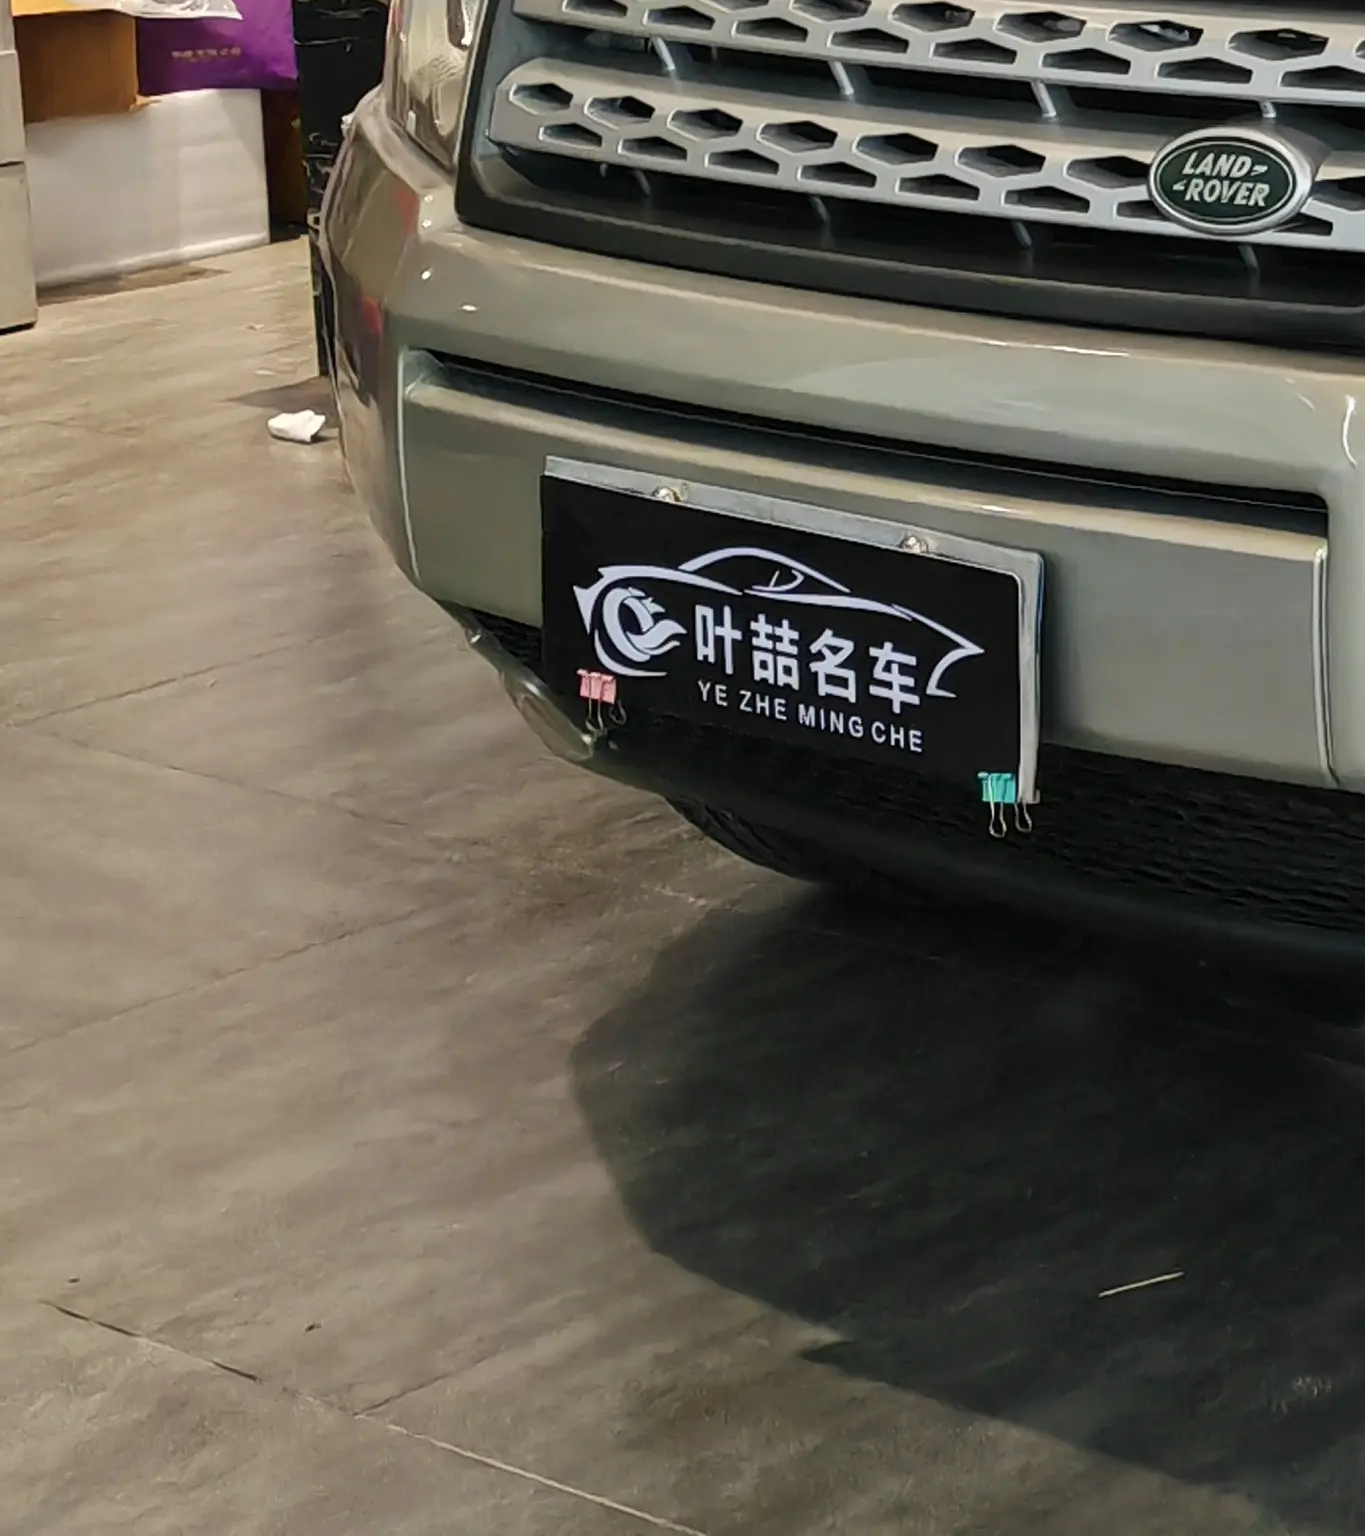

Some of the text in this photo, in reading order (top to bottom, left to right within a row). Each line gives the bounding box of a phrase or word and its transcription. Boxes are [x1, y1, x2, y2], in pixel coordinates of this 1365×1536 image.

[694, 603, 921, 714] 叶喆名车
[697, 679, 923, 753] YE ZHE MING CHE
